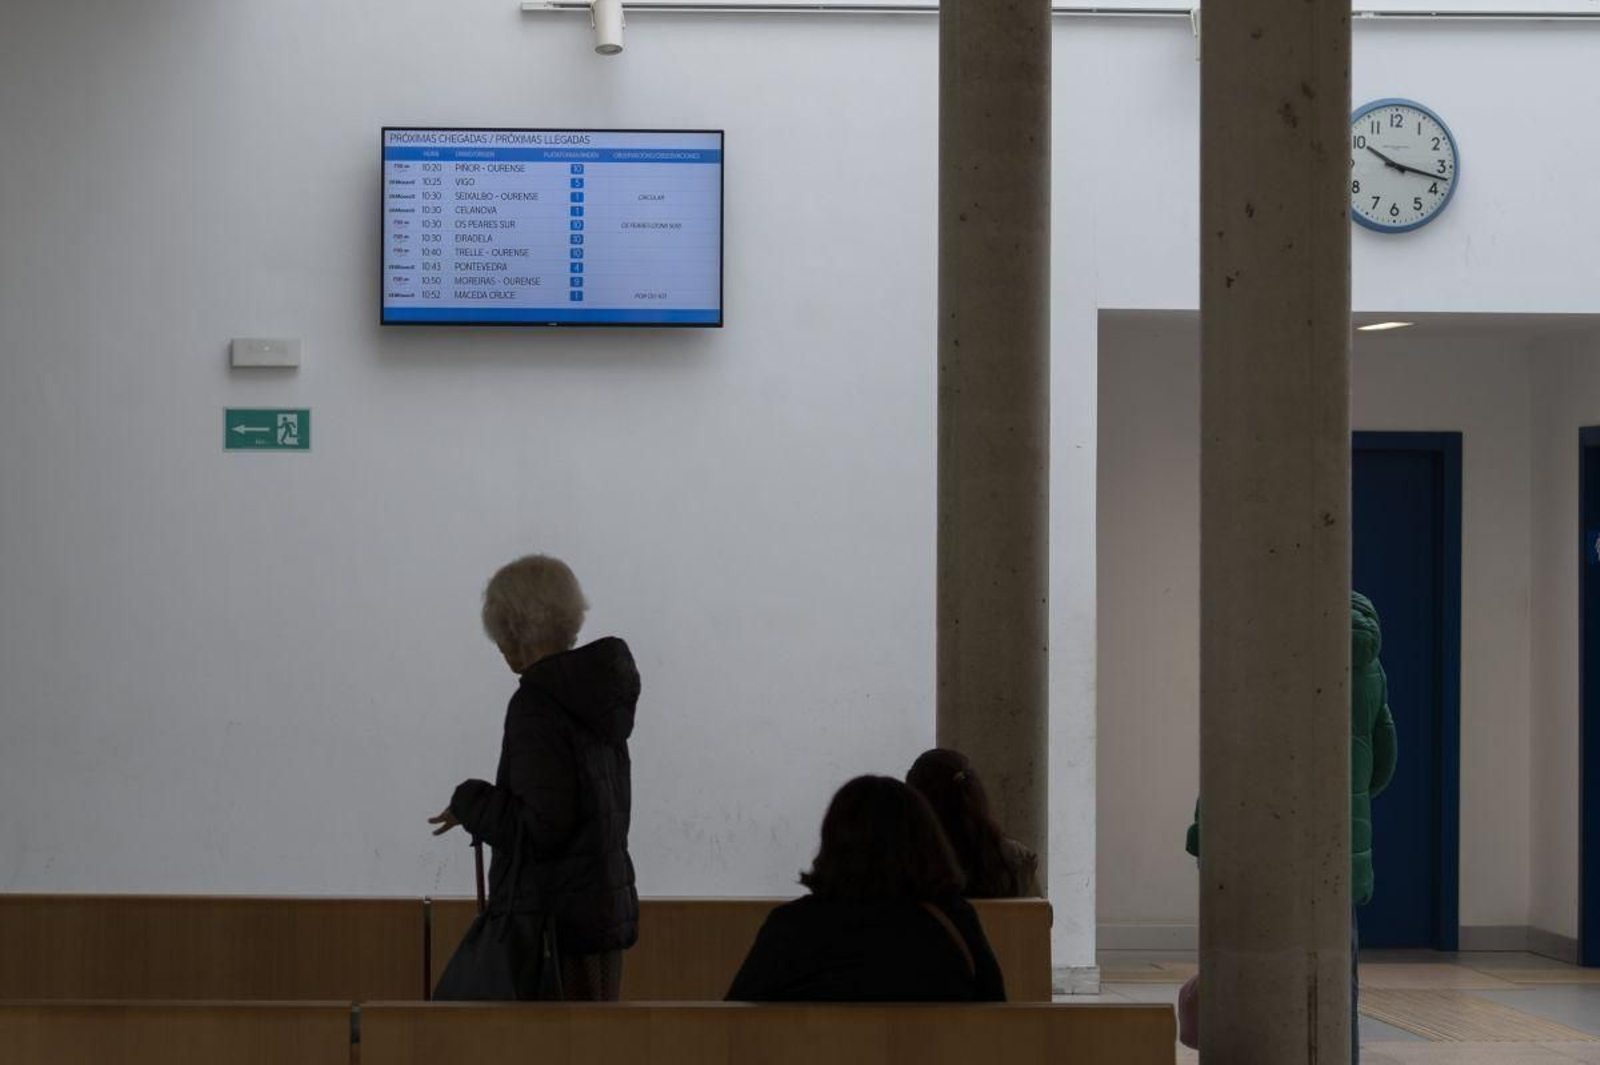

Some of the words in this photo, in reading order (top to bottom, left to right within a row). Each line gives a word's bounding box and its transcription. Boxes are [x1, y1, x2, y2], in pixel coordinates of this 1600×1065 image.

[1390, 114, 1403, 128] 12
[1371, 120, 1380, 135] 11
[1417, 121, 1421, 136] 1
[389, 131, 437, 143] PRÓXIMAS
[438, 133, 487, 144] CHEGADAS
[488, 134, 494, 144] /
[495, 132, 542, 145] PRÓXIMAS
[544, 134, 591, 145] LLEGADAS
[1353, 135, 1366, 149] 10
[1431, 136, 1441, 151] 2
[421, 163, 442, 172] 10:20
[455, 163, 481, 173] PIÑOR
[487, 163, 526, 173] OURENSE
[1437, 159, 1446, 174] 3
[421, 177, 442, 186] 10:25
[455, 177, 475, 187] VIGO
[1351, 180, 1360, 194] 8
[1428, 182, 1438, 195] 4
[421, 191, 442, 200] 10:30
[500, 192, 539, 202] OURENSE
[1371, 196, 1381, 210] 7
[1413, 197, 1423, 211] 5
[421, 205, 442, 214] 10:30
[455, 205, 498, 215] CELANOVA
[1389, 203, 1399, 217] 6
[421, 219, 442, 228] 10:30
[454, 219, 466, 229] OS
[467, 219, 498, 229] PEARES
[499, 219, 516, 229] SUR
[421, 234, 442, 242] 10:30
[454, 233, 493, 243] EIRADELA
[421, 248, 442, 257] 10:40
[454, 248, 485, 258] TRELLE
[491, 248, 530, 258] OURENSE
[454, 262, 508, 272] PONTEVEDRA
[421, 276, 442, 285] 10:50
[454, 276, 496, 286] MOREIRAS
[503, 276, 541, 286] OURENSE
[421, 290, 442, 299] 10:52
[454, 290, 488, 300] MACEDA
[489, 290, 516, 300] CRUCE
